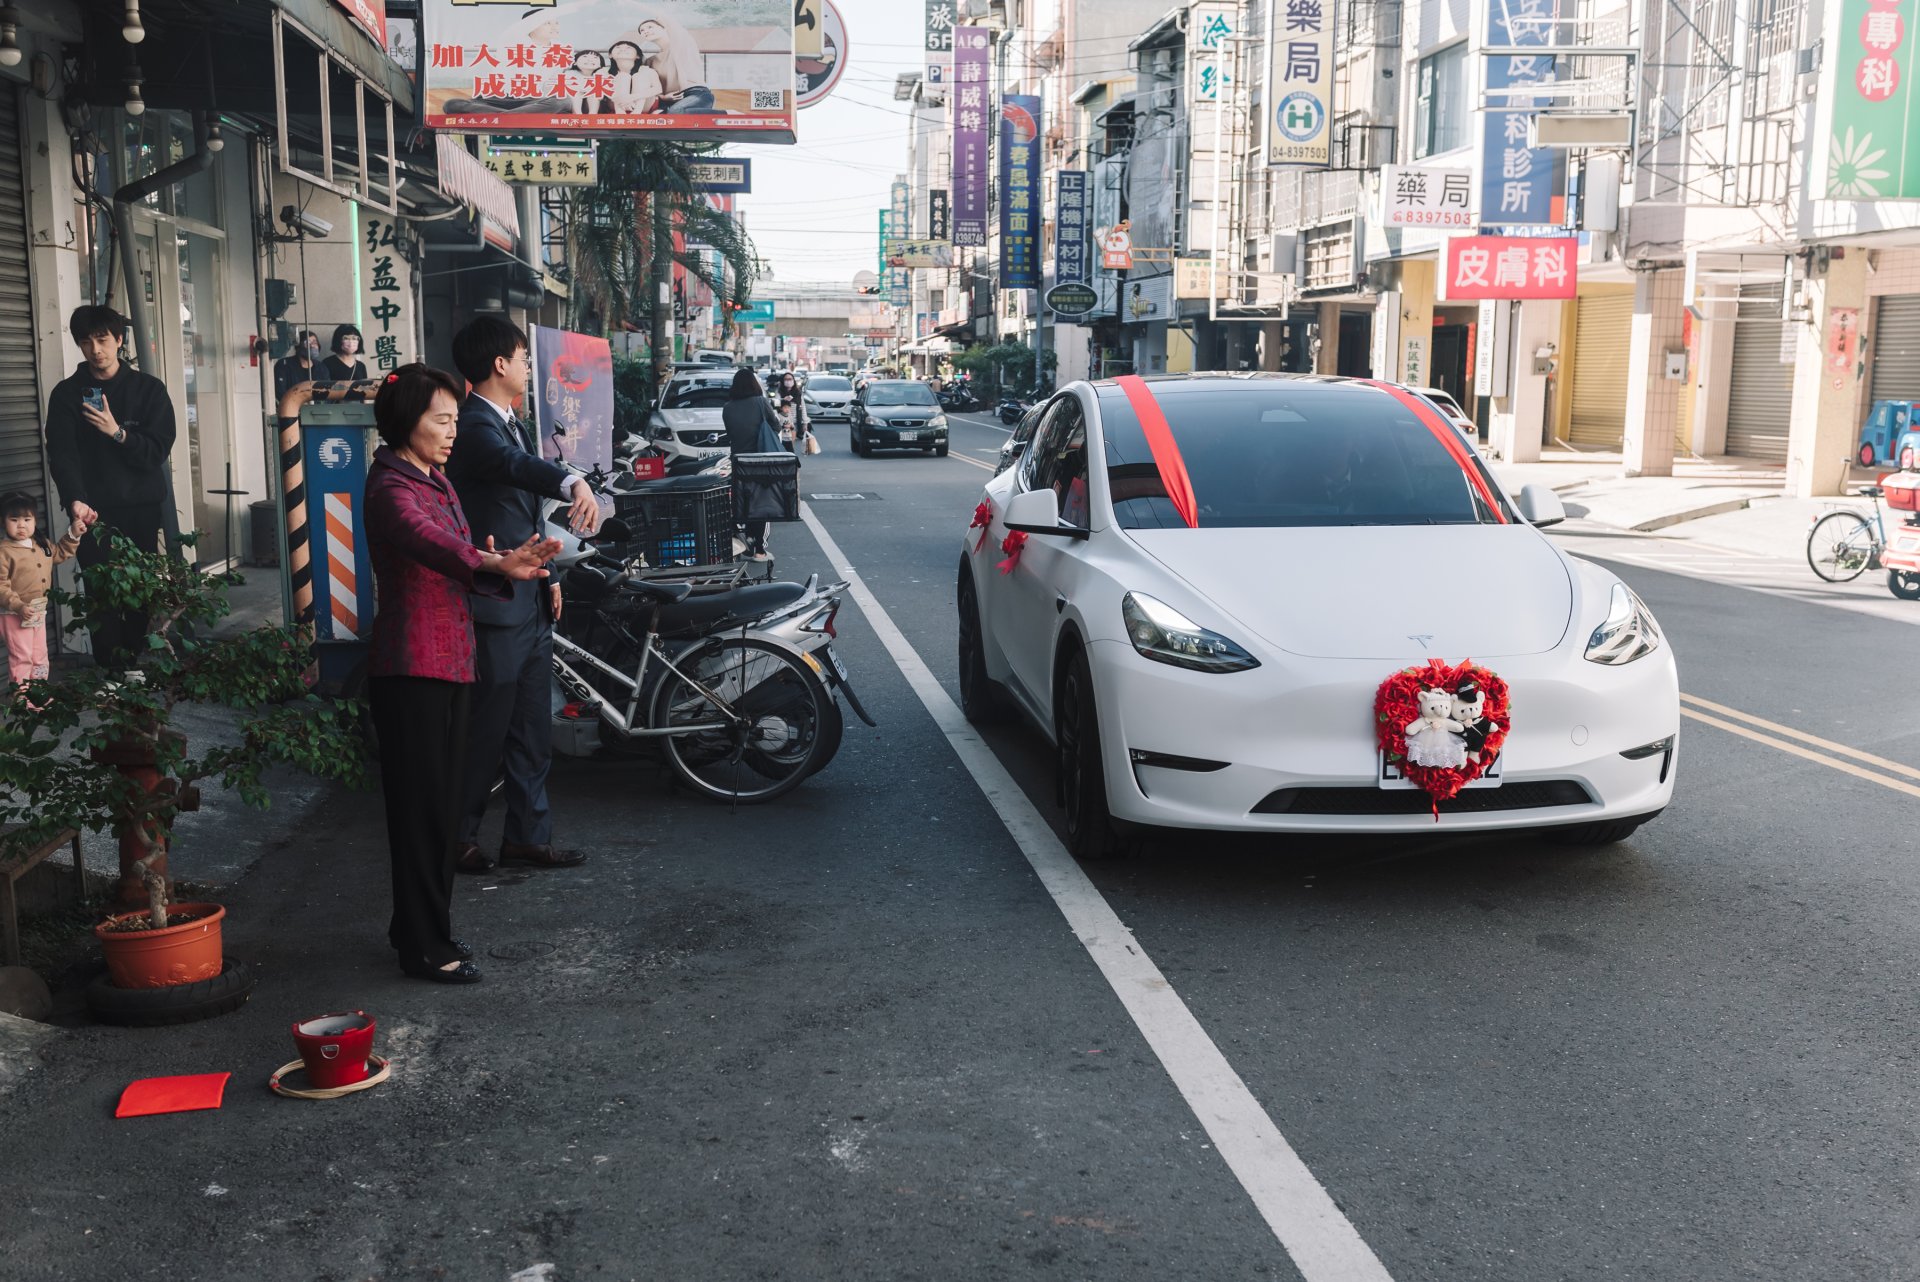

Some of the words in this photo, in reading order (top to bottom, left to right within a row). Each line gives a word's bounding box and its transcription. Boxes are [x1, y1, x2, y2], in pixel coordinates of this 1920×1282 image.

[431, 43, 575, 69] 加入東森
[472, 73, 616, 99] 成就未來
[960, 61, 981, 133] 詩威特
[1272, 146, 1327, 159] 04-8397503
[1009, 146, 1030, 231] 春風滿面
[1396, 171, 1470, 208] 藥局
[1058, 174, 1082, 284] 正隆機車材料
[1406, 211, 1471, 225] 8397503
[1455, 245, 1568, 288] 皮膚科
[1406, 340, 1421, 386] 社區健康
